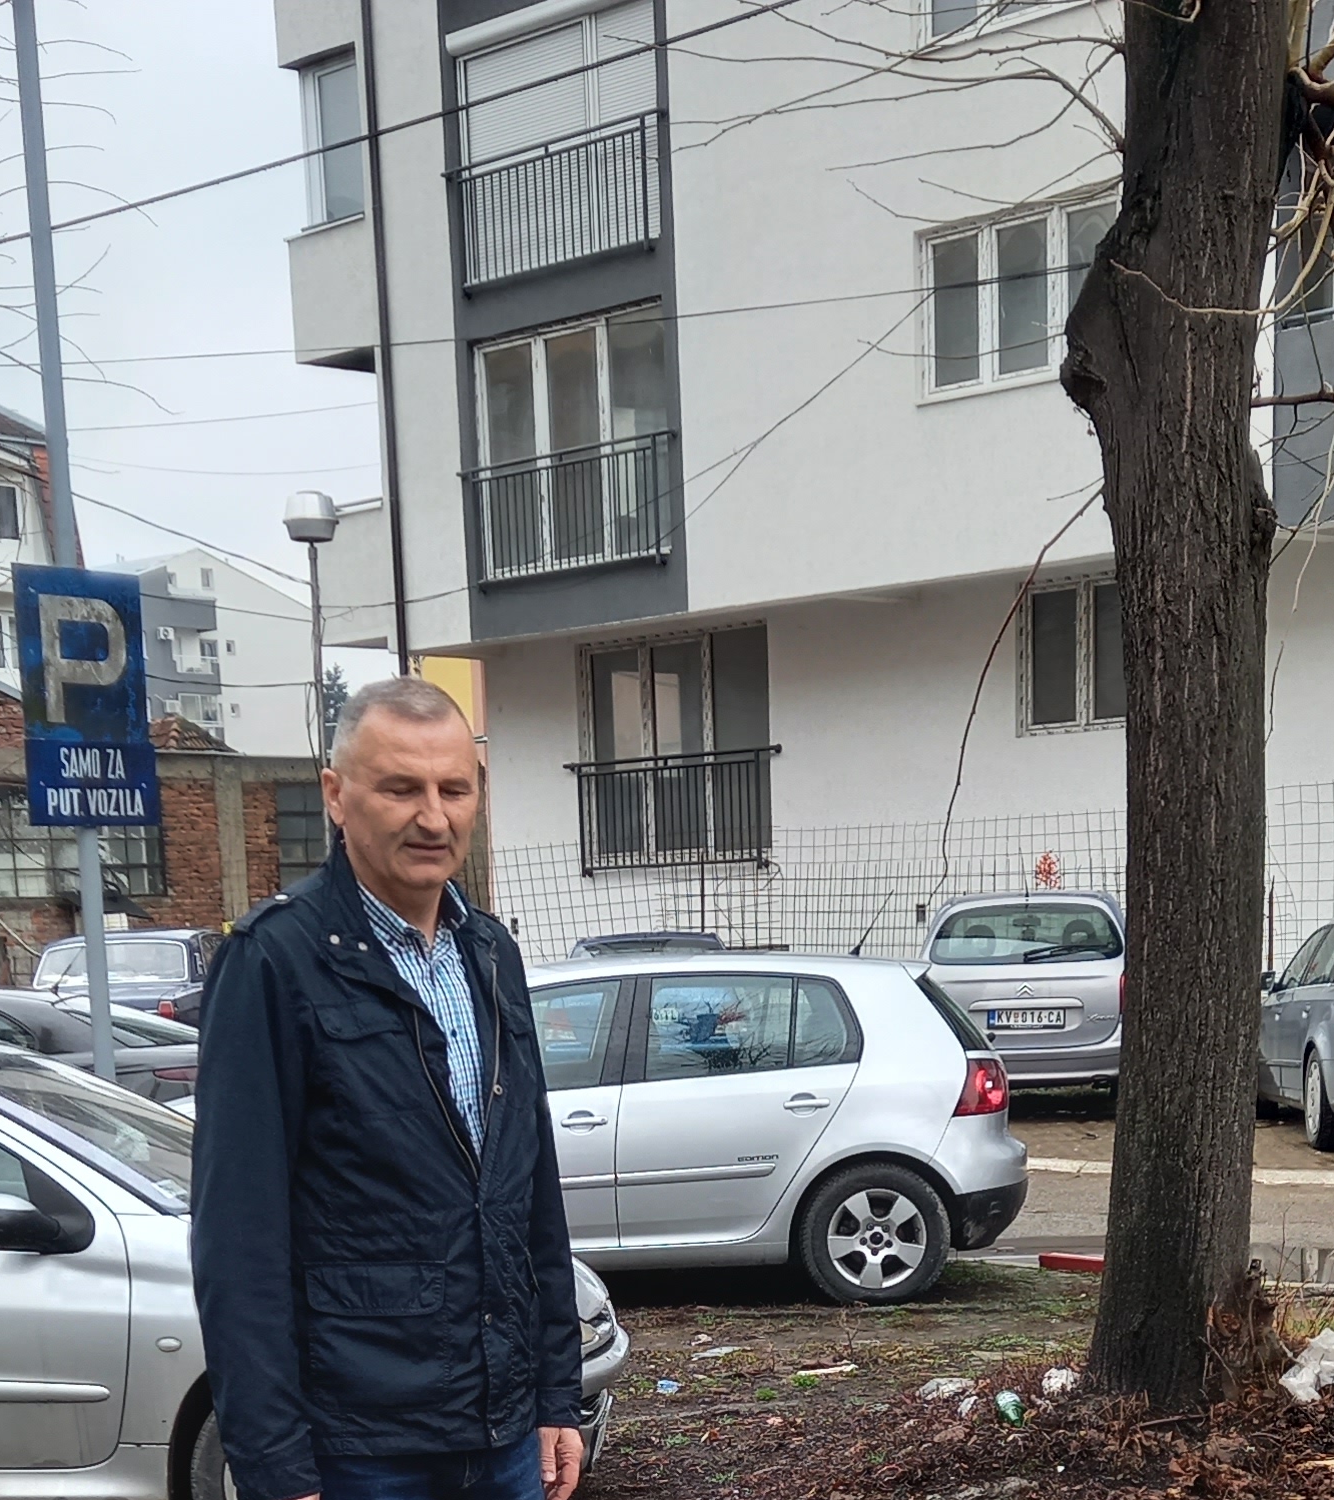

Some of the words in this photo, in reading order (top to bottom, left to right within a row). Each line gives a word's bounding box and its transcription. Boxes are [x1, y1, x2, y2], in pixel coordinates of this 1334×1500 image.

[38, 593, 127, 723] P
[60, 747, 101, 779] SAMO
[107, 749, 126, 779] ZA
[86, 788, 145, 817] VOZILA
[996, 1010, 1012, 1024] KV
